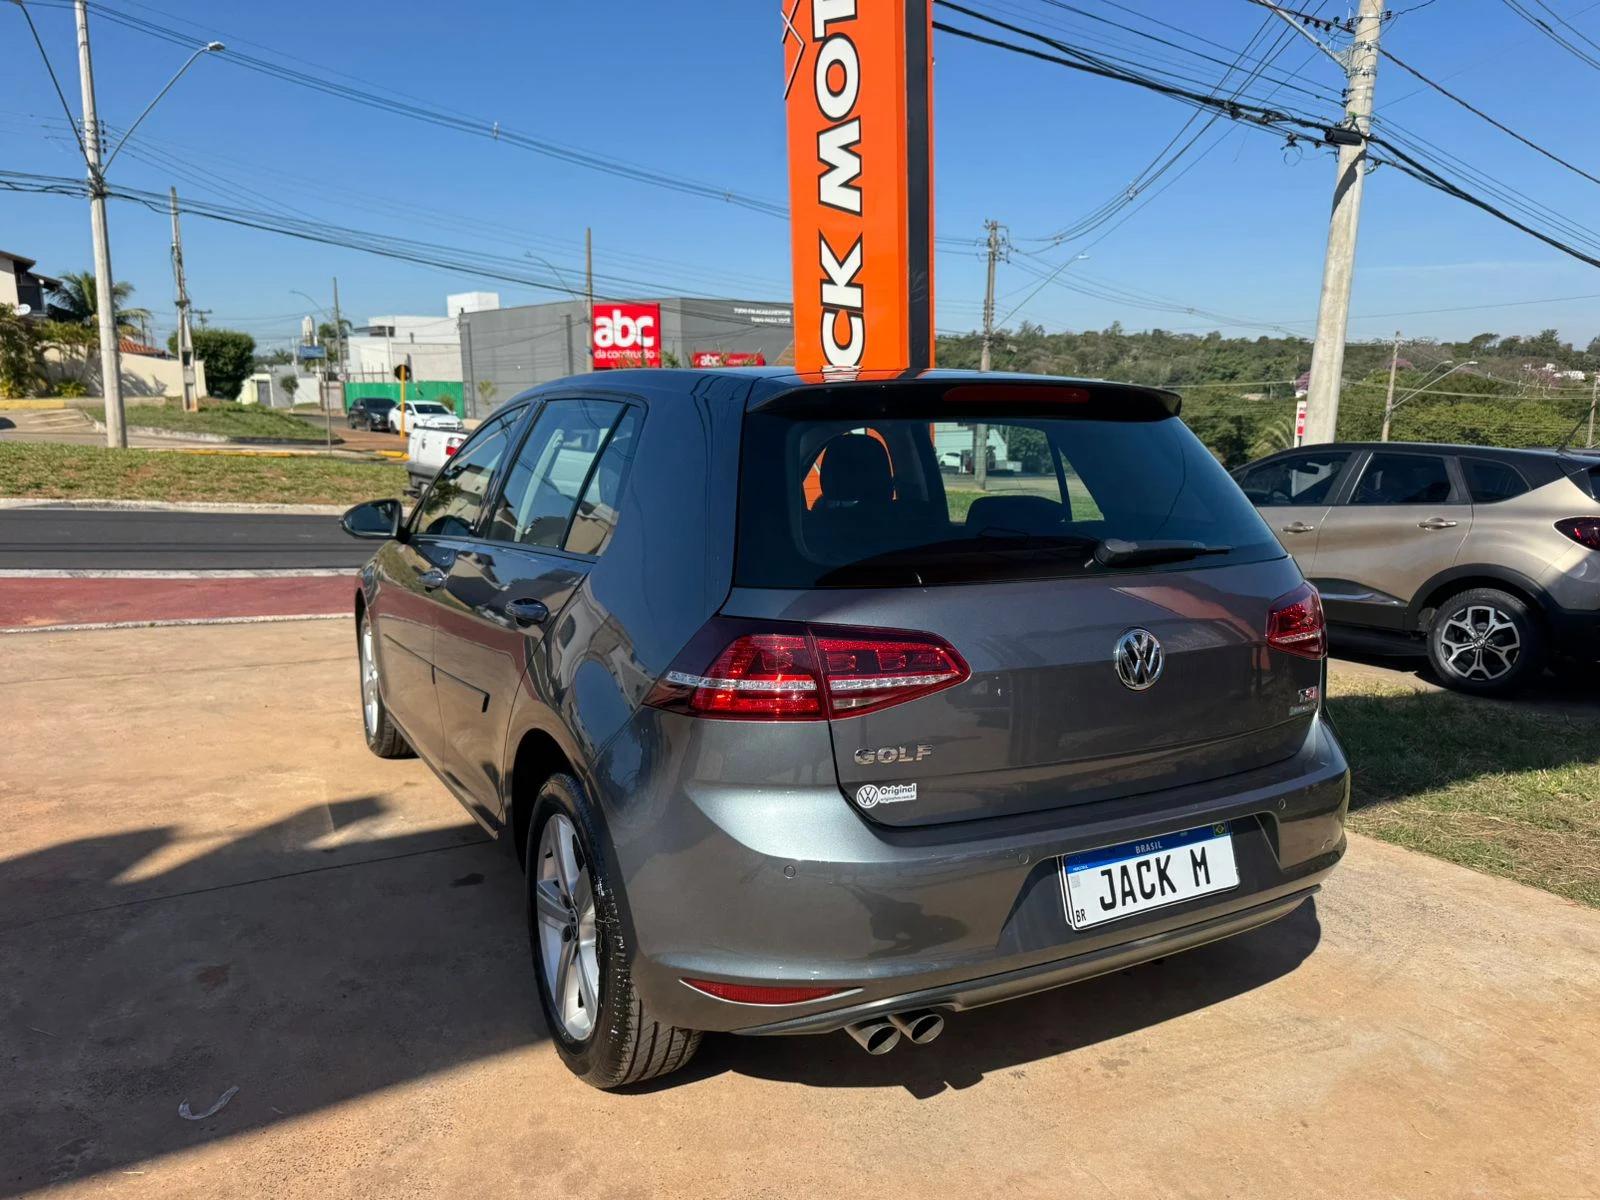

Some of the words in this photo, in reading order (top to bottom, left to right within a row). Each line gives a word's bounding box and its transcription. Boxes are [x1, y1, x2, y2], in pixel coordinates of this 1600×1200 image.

[594, 309, 655, 348] abc
[854, 744, 934, 765] GOLF
[880, 784, 915, 796] Original
[1135, 840, 1163, 854] BRASIL
[1100, 854, 1177, 911] JACK
[1190, 846, 1211, 887] M
[1075, 908, 1087, 923] BR
